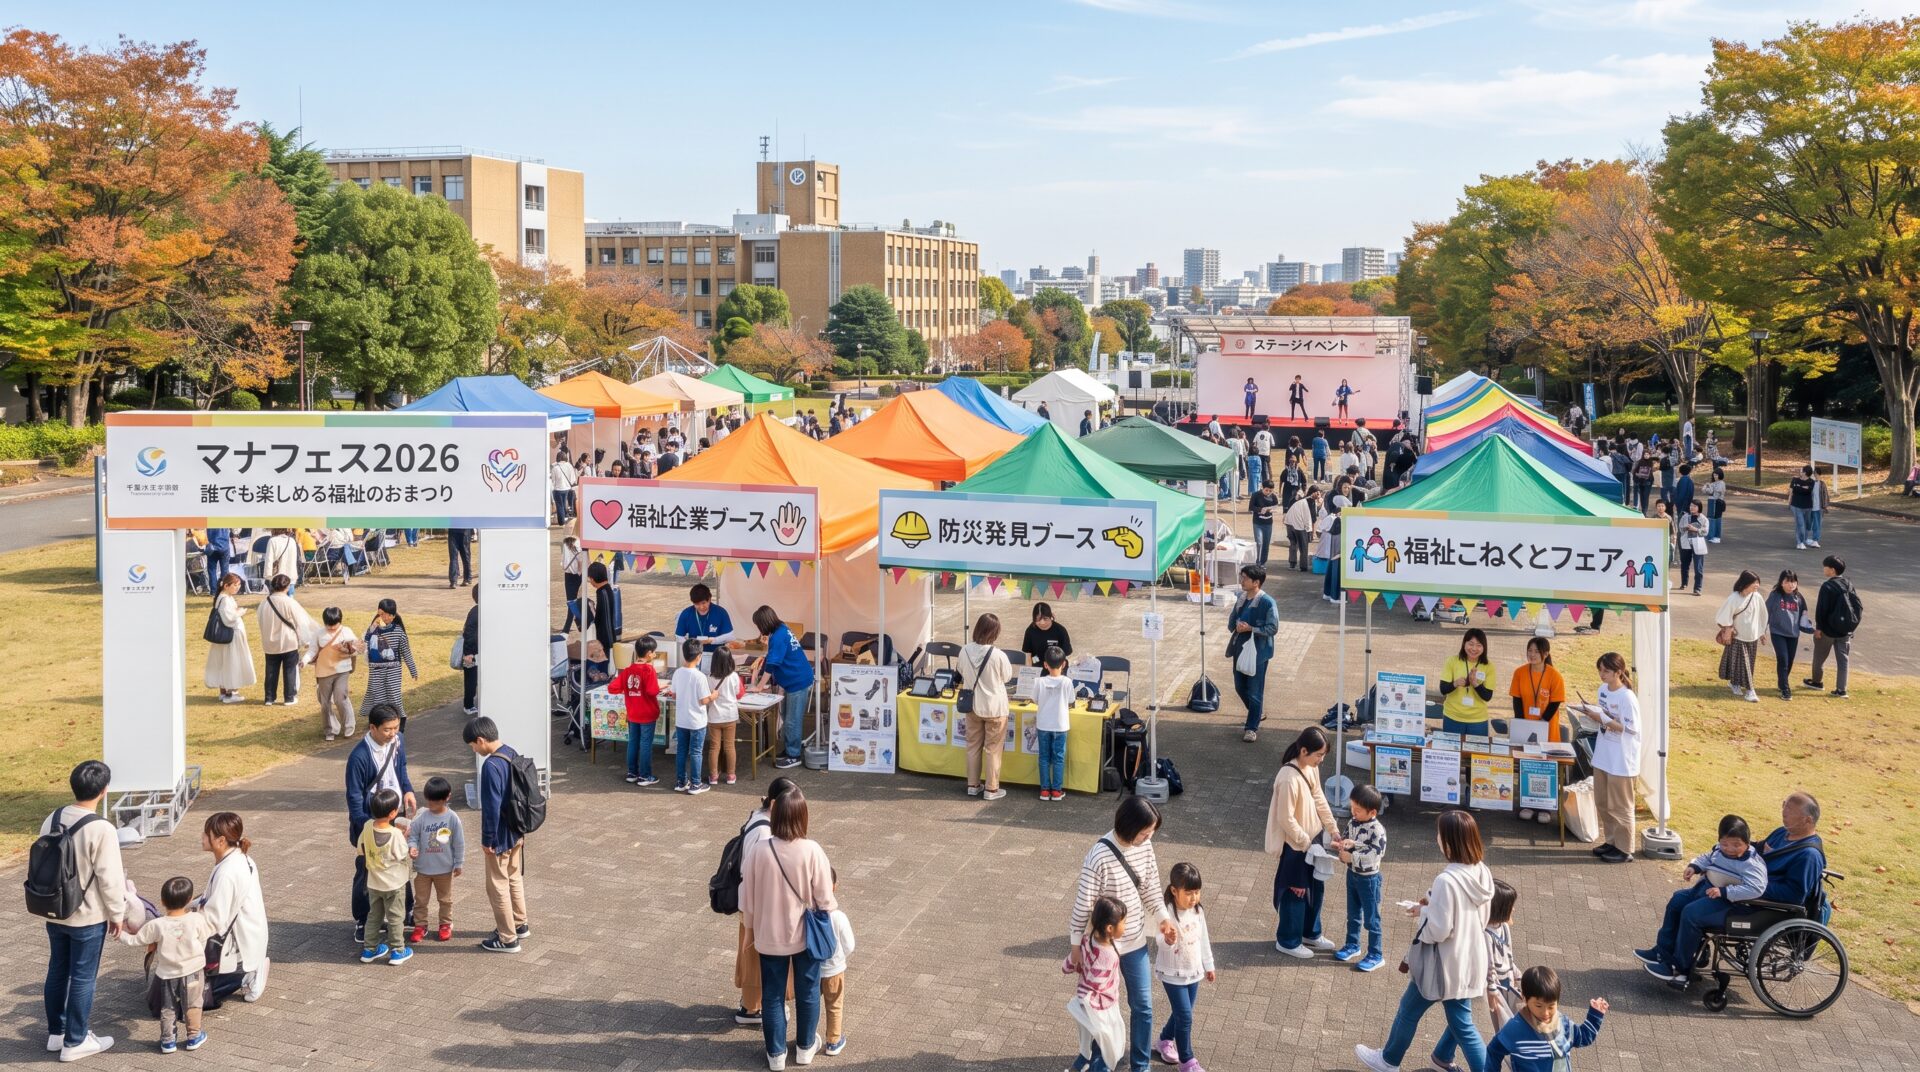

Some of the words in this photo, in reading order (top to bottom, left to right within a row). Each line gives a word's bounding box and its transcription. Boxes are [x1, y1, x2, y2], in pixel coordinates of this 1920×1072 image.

[1254, 339, 1348, 351] ステージイベント
[197, 442, 459, 474] マナフェス2026
[200, 484, 453, 504] 誰でも楽しめる福祉のおまつり
[627, 503, 767, 532] 福祉企業ブース
[939, 518, 1096, 550] 防災発見ブース
[1404, 536, 1624, 573] 福祉こねくとフェア
